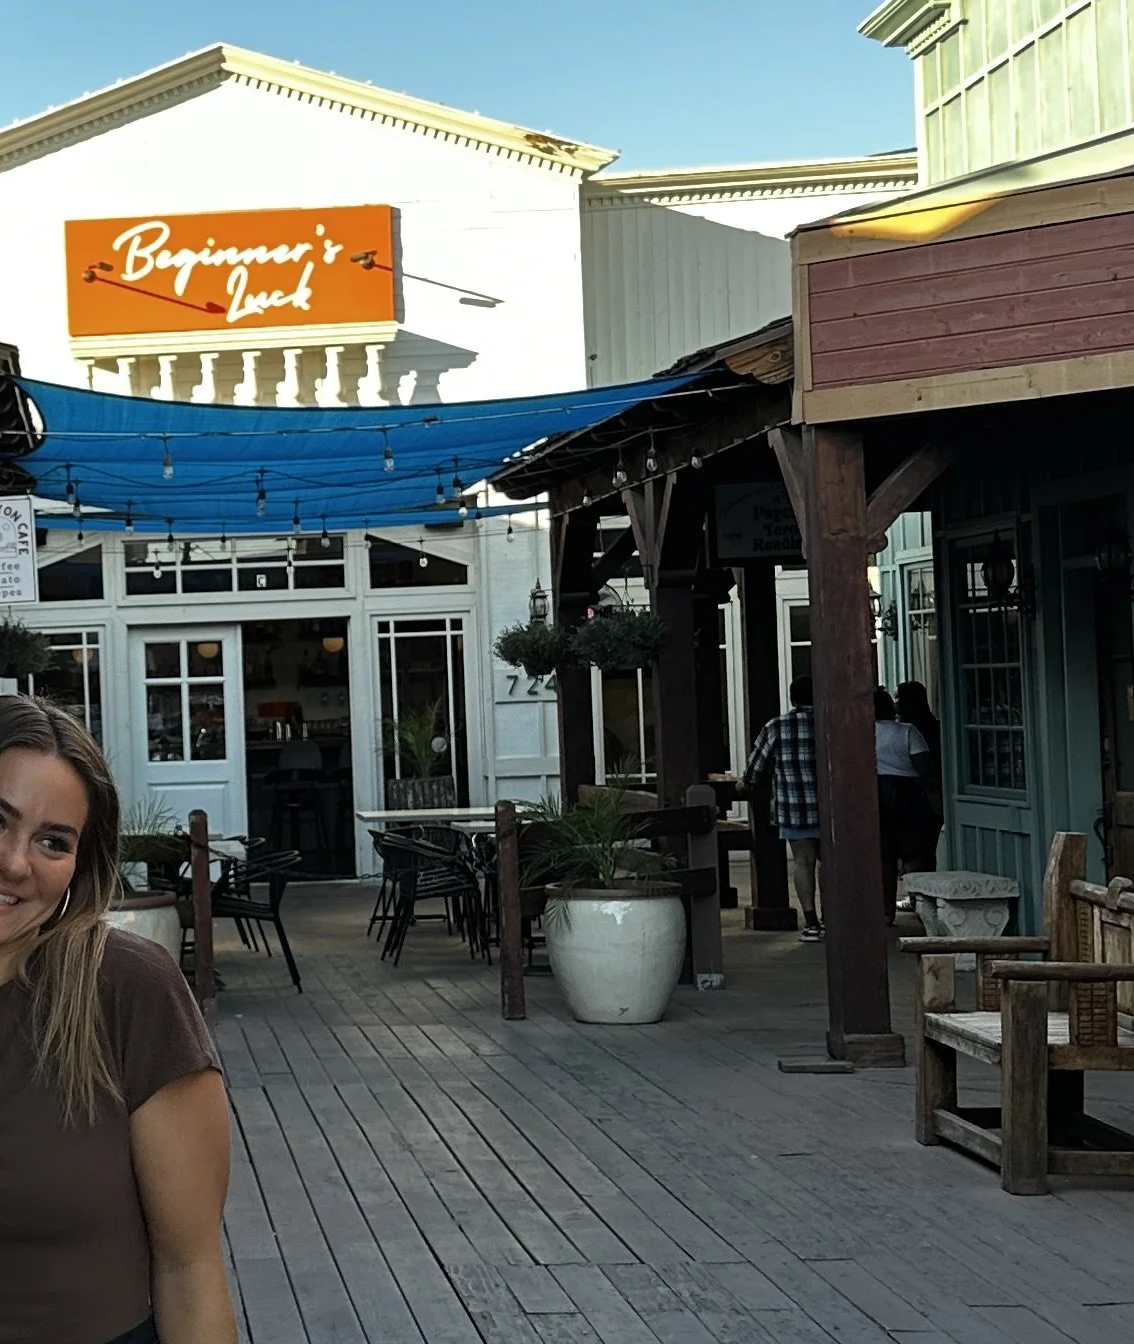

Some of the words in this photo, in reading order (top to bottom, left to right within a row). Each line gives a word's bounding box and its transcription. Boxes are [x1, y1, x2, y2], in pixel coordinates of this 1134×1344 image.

[112, 220, 344, 296] Beginner's
[226, 260, 315, 323] Luck
[17, 522, 30, 556] CAFE
[763, 522, 797, 536] Taro
